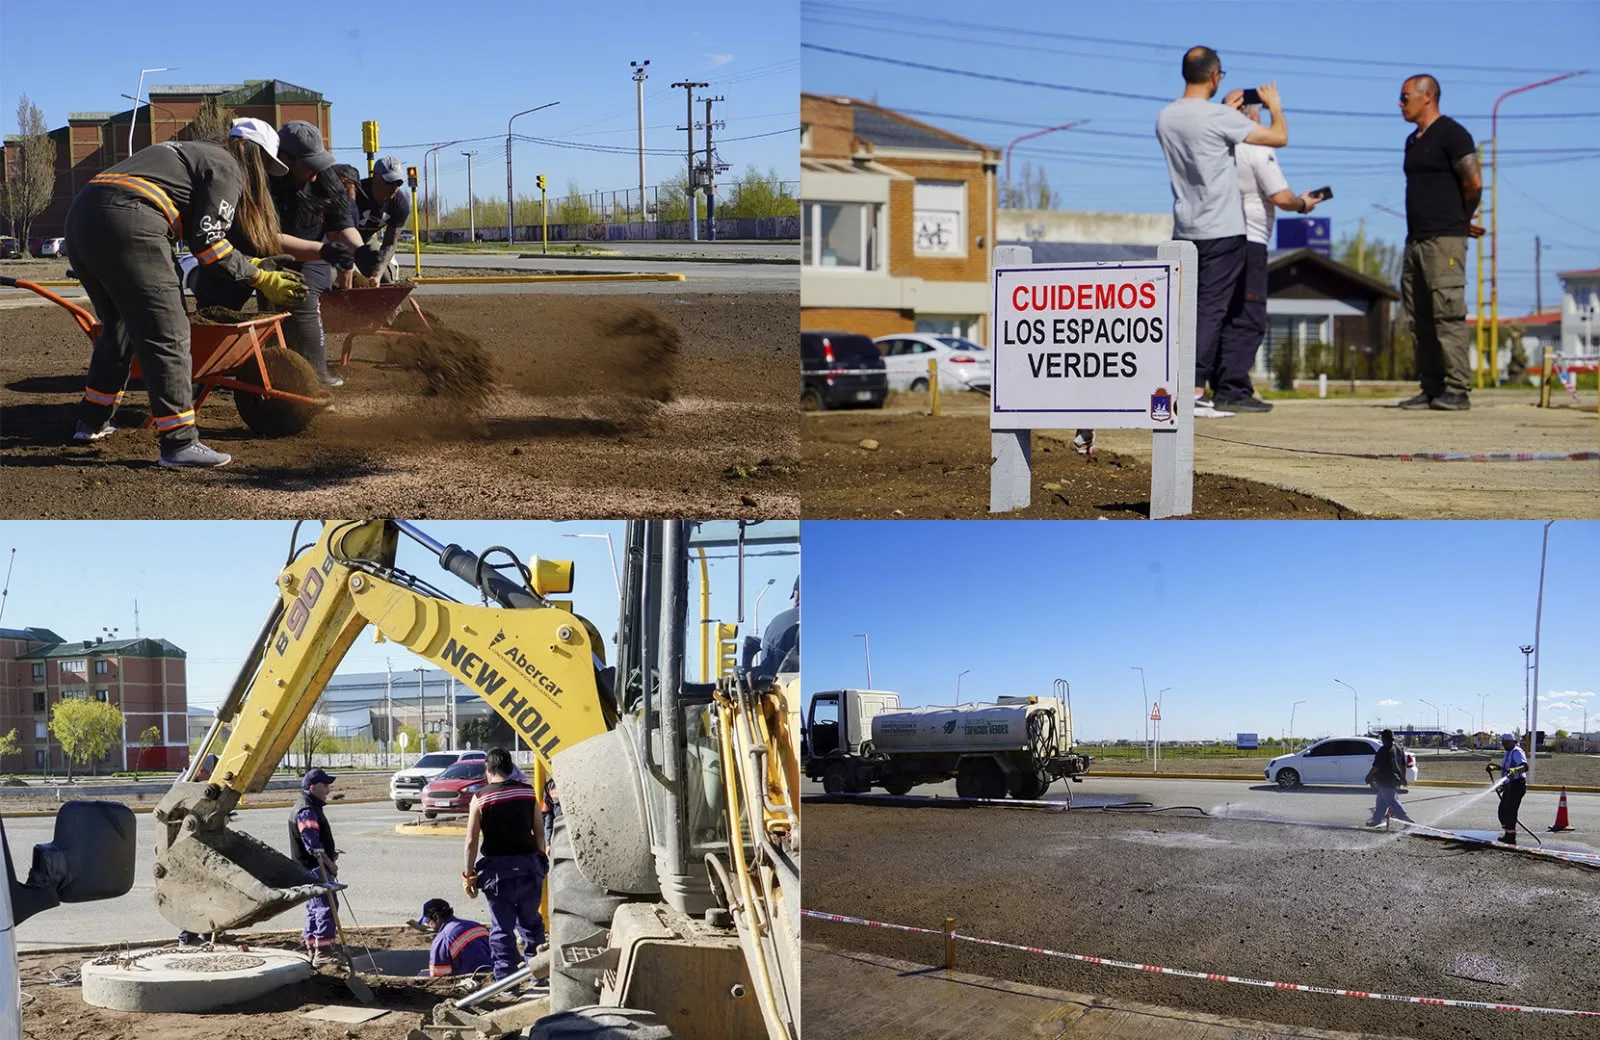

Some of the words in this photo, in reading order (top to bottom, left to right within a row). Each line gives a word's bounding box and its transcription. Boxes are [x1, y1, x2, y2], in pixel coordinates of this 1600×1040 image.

[1012, 283, 1156, 311] CUIDEMOS
[1004, 319, 1046, 345] LOS
[1053, 317, 1163, 344] ESPACIOS
[1028, 352, 1138, 378] VERDES
[504, 647, 563, 697] Abercar
[441, 637, 508, 696] NEW
[499, 687, 561, 765] HOLL
